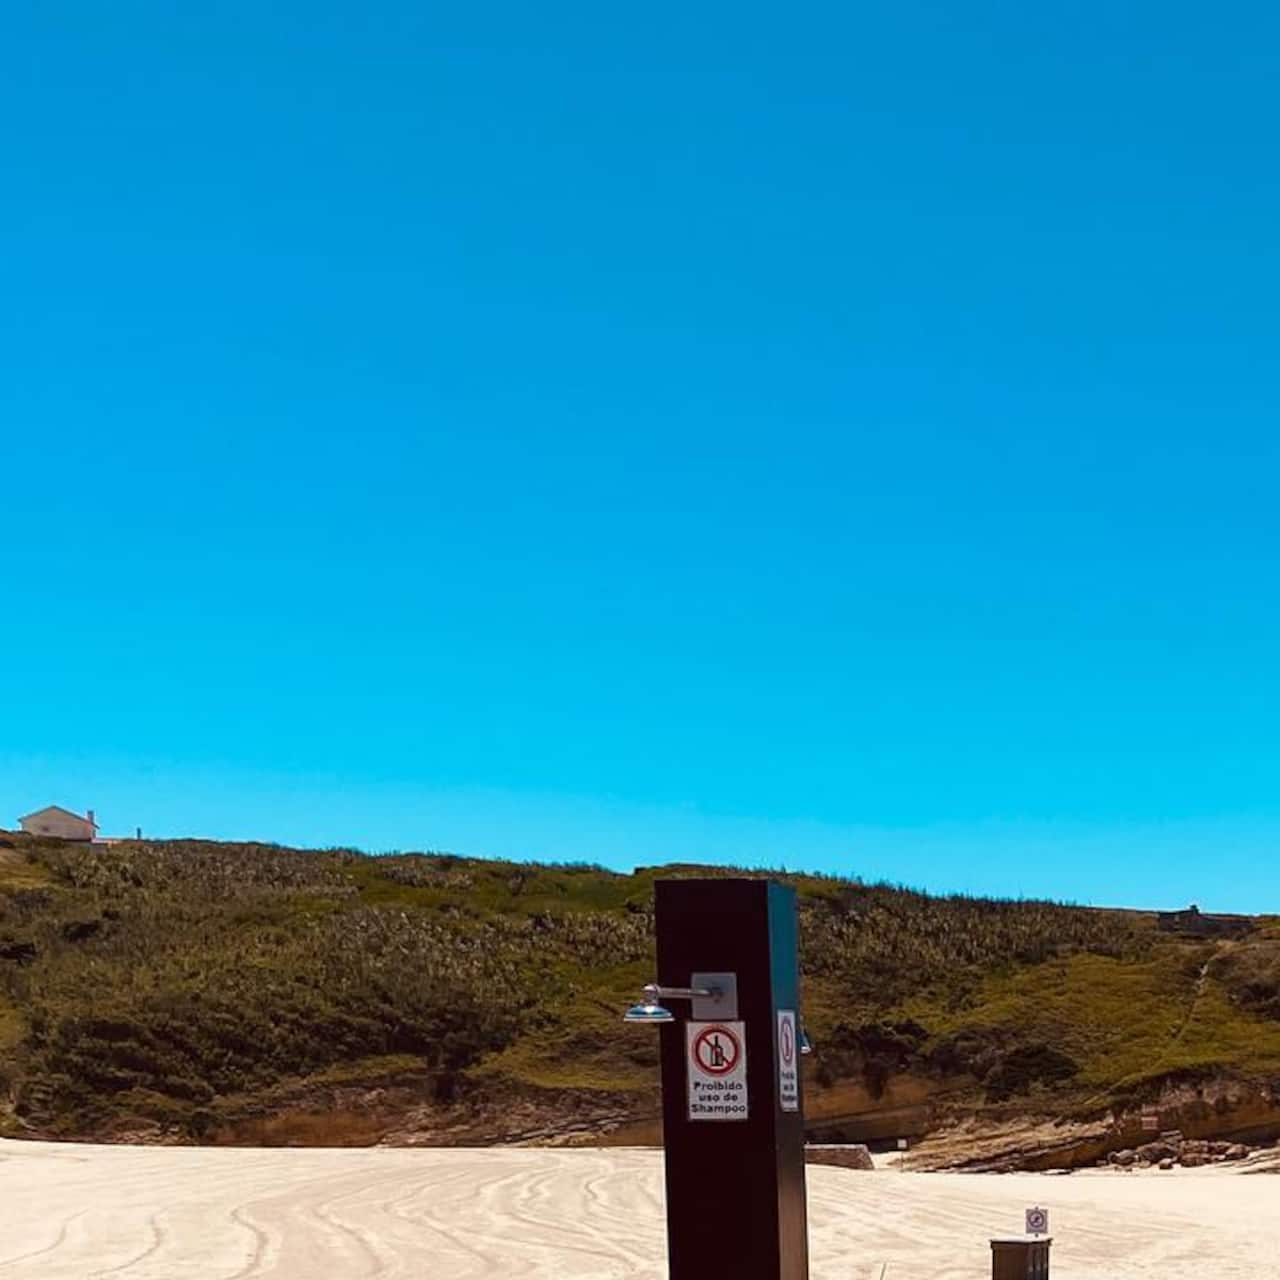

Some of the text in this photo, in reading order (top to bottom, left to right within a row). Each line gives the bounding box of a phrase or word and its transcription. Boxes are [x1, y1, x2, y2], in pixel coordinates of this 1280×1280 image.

[693, 1080, 743, 1091] Proibido
[698, 1091, 738, 1102] uso de
[691, 1103, 746, 1114] Shampoo
